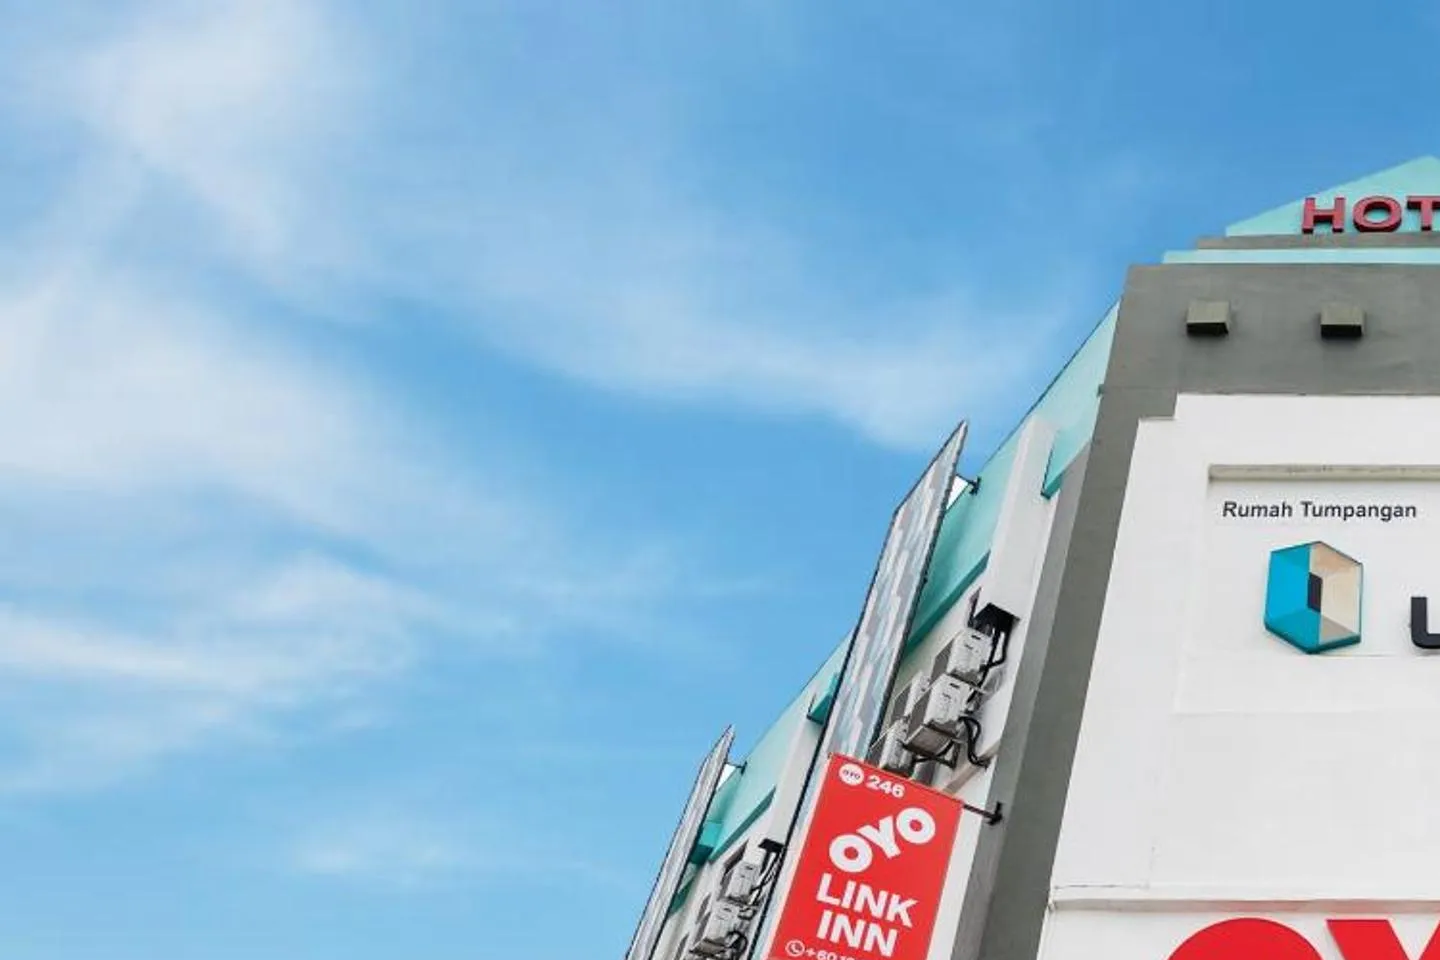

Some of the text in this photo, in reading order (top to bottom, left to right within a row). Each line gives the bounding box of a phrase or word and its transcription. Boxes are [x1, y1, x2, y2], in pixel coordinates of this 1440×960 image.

[1222, 500, 1417, 522] Rumah Tumpangan
[866, 774, 905, 798] 246
[829, 807, 936, 873] OYO
[816, 872, 919, 928] LINK
[816, 910, 898, 957] INN
